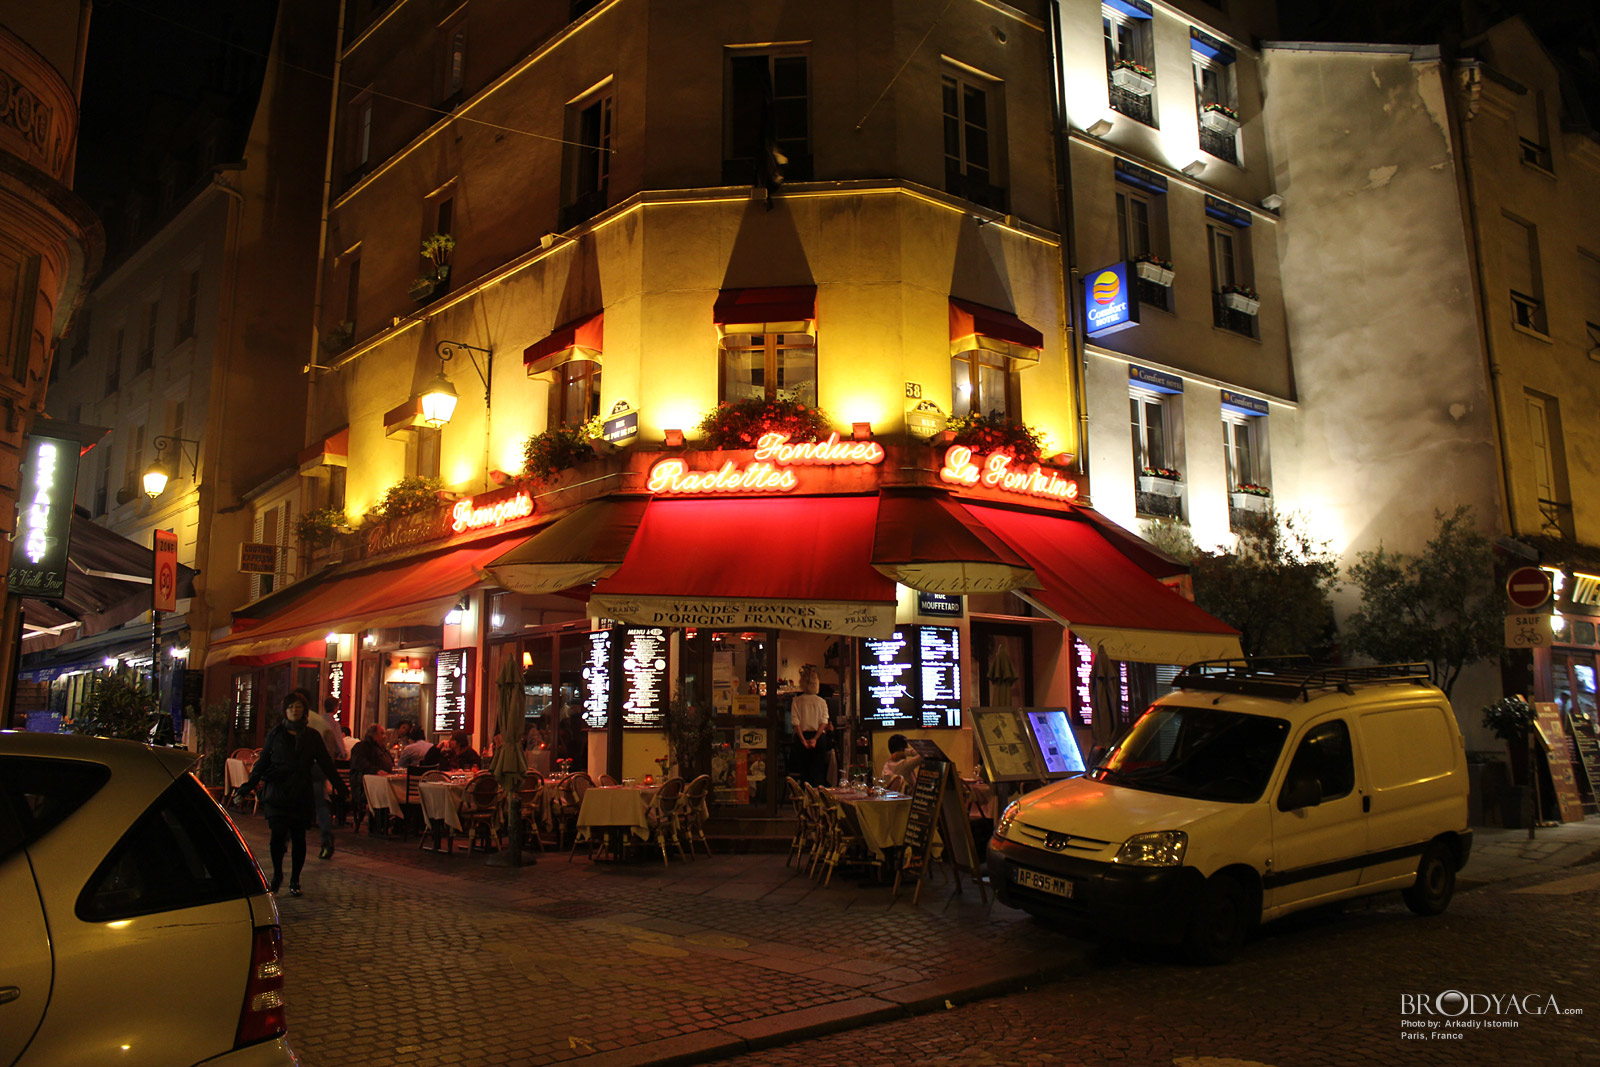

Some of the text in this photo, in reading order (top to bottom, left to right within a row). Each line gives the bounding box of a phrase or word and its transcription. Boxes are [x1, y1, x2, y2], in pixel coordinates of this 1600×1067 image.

[1124, 163, 1150, 181] Comfort
[1213, 199, 1237, 216] Comfort
[1088, 300, 1127, 321] Comfort
[1095, 312, 1120, 327] HOTEL
[1138, 370, 1166, 386] Comfort
[906, 383, 921, 398] 58
[1230, 394, 1253, 409] Comfort
[921, 418, 937, 428] RUE
[754, 431, 884, 463] Fondues
[647, 458, 797, 492] Raclettes
[941, 446, 1078, 500] La Fontaine
[452, 491, 533, 533] Français
[160, 540, 174, 554] ZONE
[673, 604, 816, 617] VIANDES BOVINES
[921, 601, 960, 611] MOUFFETARD
[653, 612, 832, 631] D'ORIGINE FRANÇAISE
[1516, 616, 1541, 626] SAUF
[1018, 870, 1066, 895] AP-895-MM
